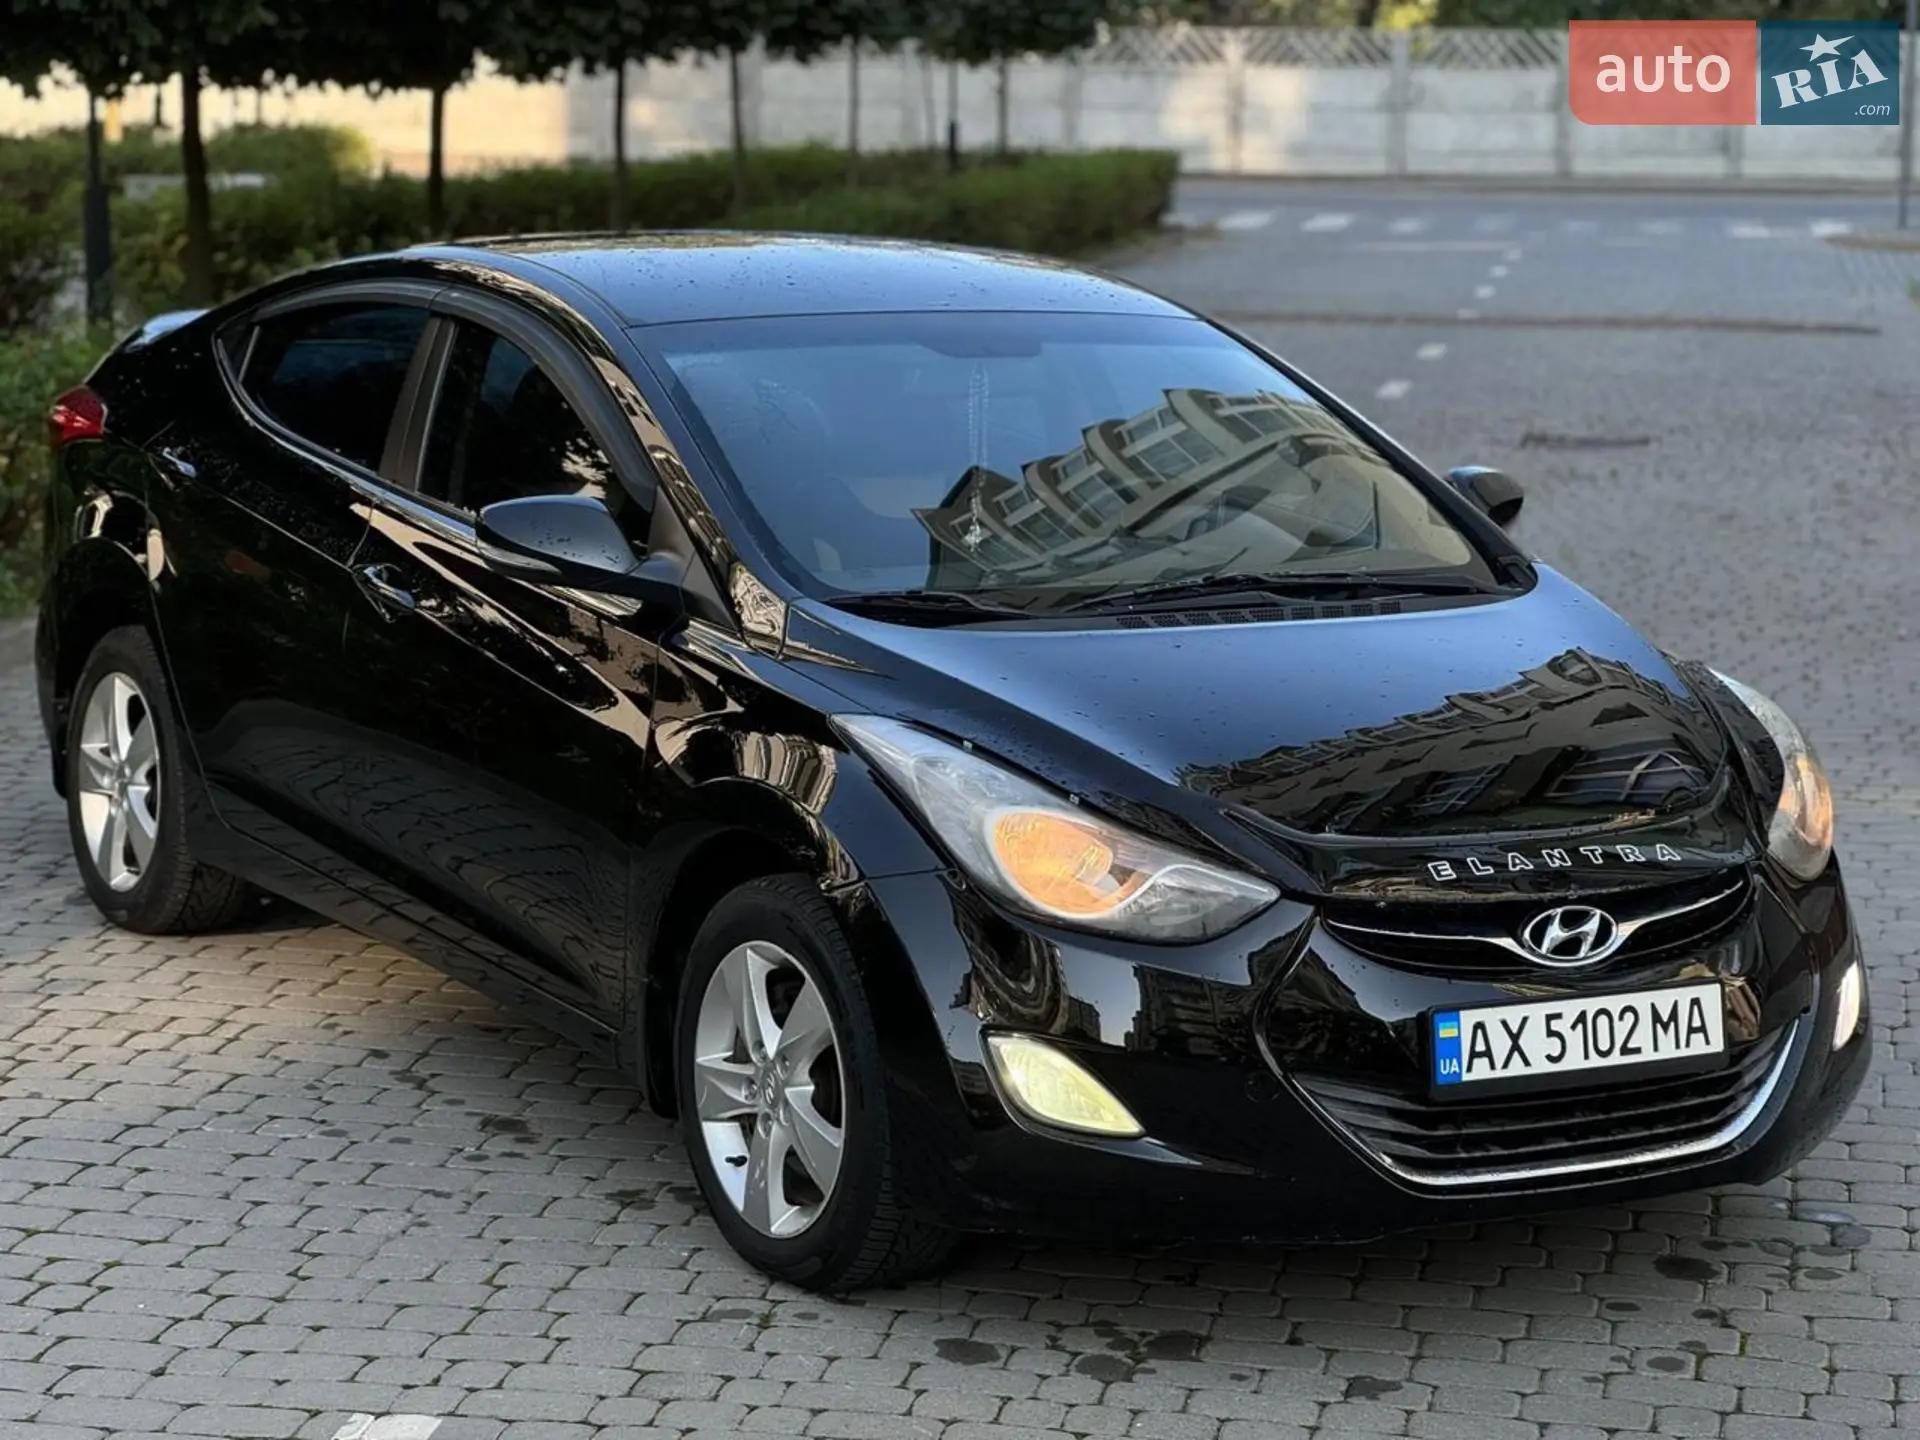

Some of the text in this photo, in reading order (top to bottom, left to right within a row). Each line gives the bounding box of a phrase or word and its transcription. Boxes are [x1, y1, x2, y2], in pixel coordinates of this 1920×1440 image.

[1427, 843, 1682, 882] ELANTRA
[1465, 997, 1711, 1074] AX 5102 MA
[1440, 1058, 1460, 1075] UA
